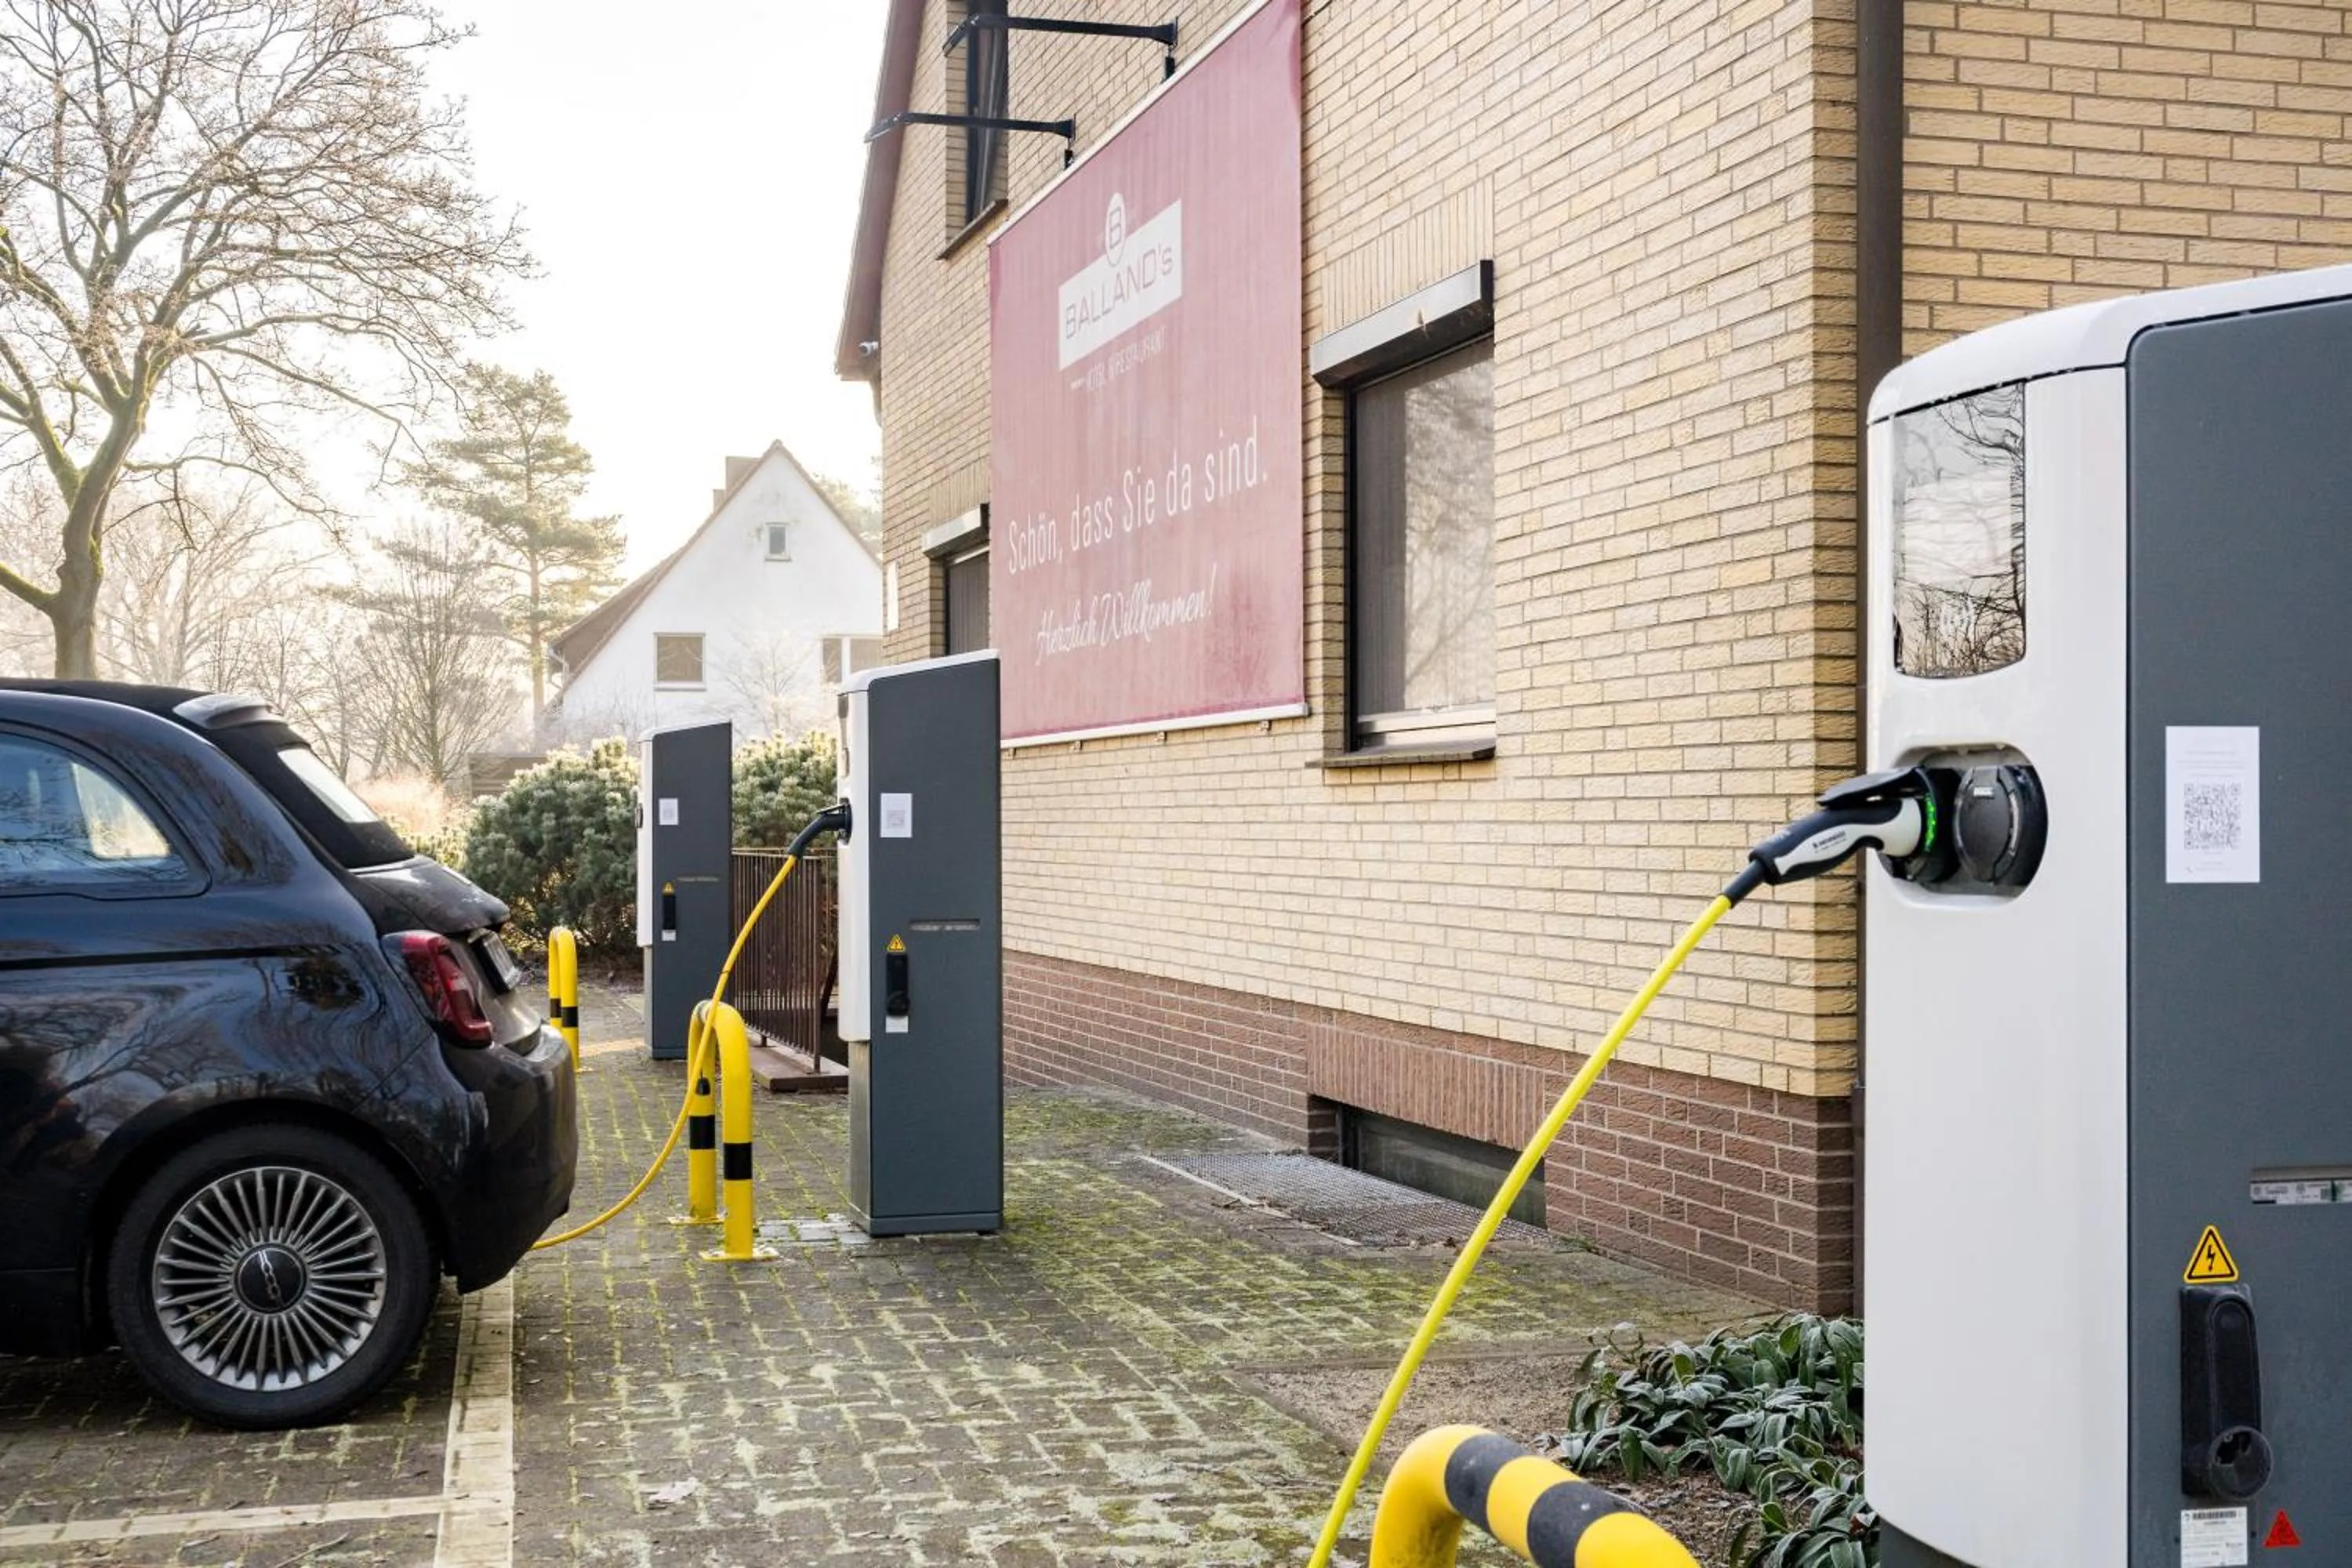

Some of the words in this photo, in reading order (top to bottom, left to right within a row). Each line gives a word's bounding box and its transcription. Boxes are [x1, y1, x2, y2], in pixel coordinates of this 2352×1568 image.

[1109, 205, 1122, 249] B
[1065, 242, 1174, 339] BALLAND's
[1008, 513, 1063, 575] Schön,
[1070, 492, 1114, 552] dass
[1123, 466, 1156, 533] Sie
[1165, 448, 1192, 517] da
[1204, 415, 1269, 503] sind.
[1033, 594, 1098, 666] Herzlich
[1099, 562, 1218, 648] Willkommen!
